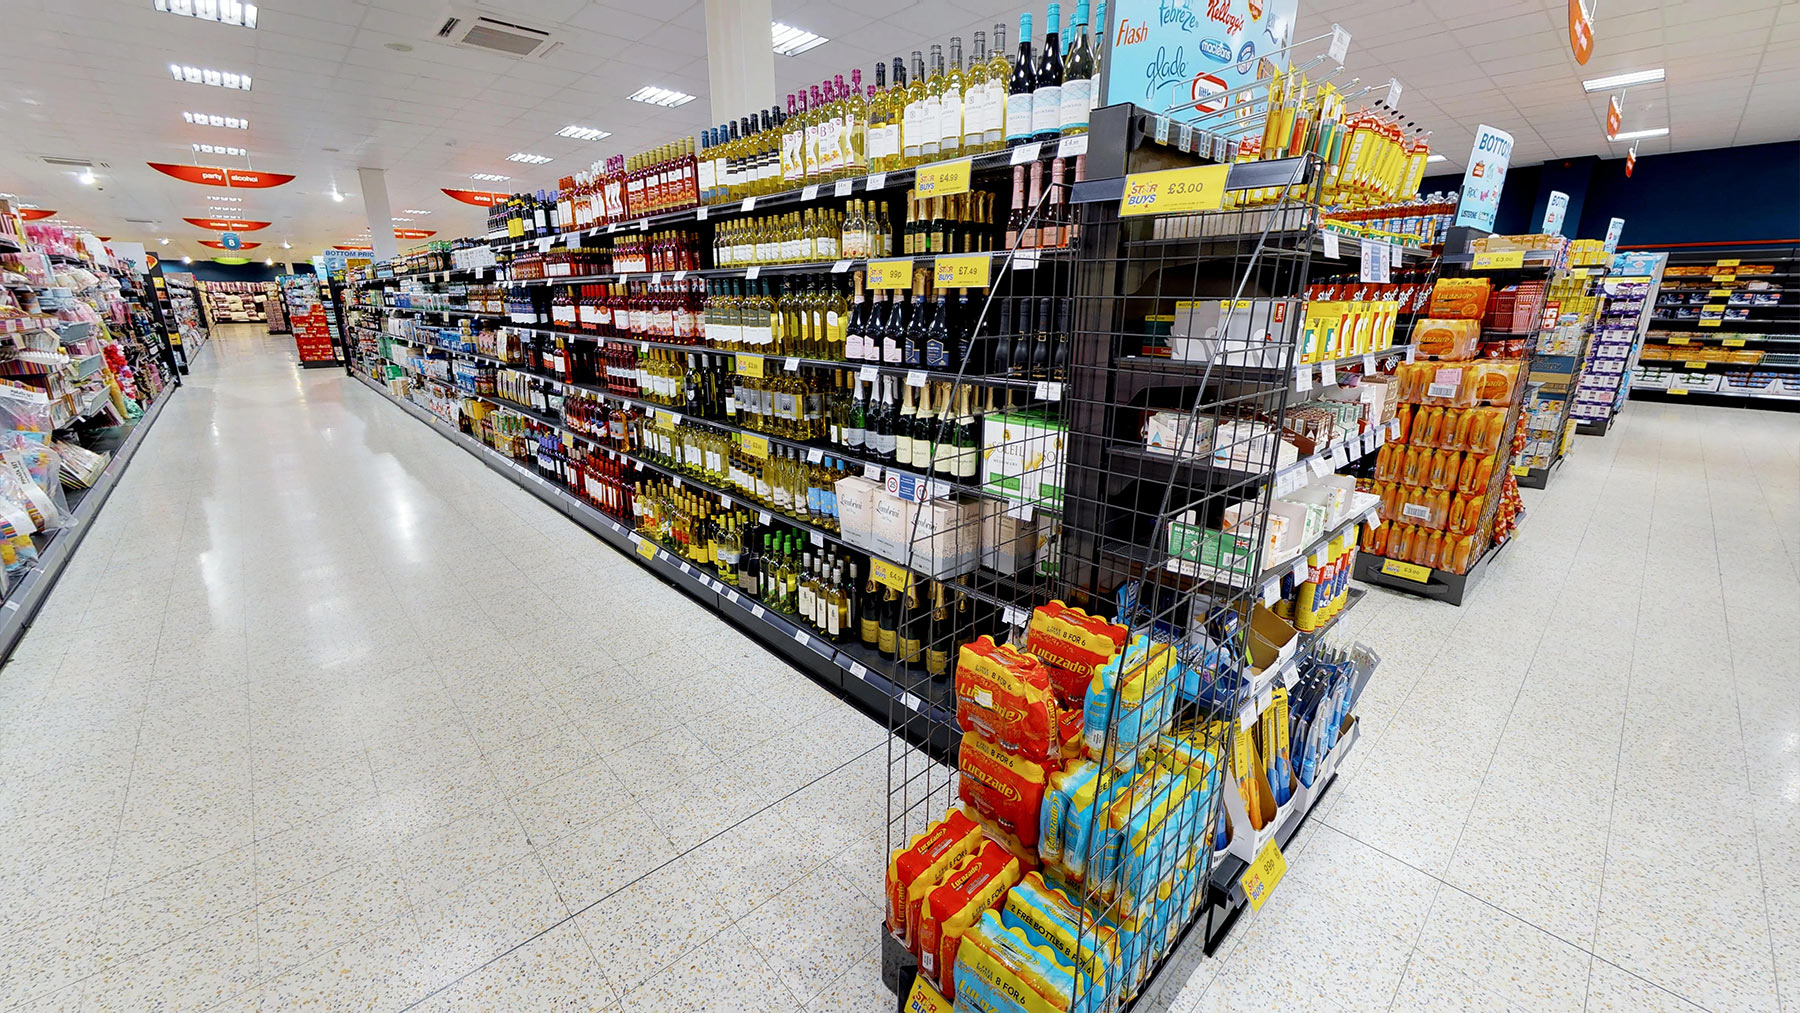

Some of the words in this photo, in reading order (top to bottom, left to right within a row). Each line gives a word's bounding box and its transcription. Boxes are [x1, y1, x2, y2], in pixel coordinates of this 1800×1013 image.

[1206, 0, 1244, 36] Kellogg's
[1116, 18, 1148, 47] Flash
[1201, 41, 1231, 61] macleans
[1146, 46, 1187, 100] glade
[920, 183, 935, 191] BUYS
[940, 173, 958, 182] £4.99
[1167, 182, 1204, 194] £3.00
[1128, 194, 1157, 205] BUYS
[228, 239, 235, 247] 8
[889, 270, 902, 279] 99p
[938, 273, 954, 281] BUYS
[958, 266, 978, 276] £7.49
[1403, 567, 1421, 575] £3.00
[1062, 631, 1068, 639] 8
[1068, 633, 1082, 645] FOR
[1081, 639, 1086, 647] 6
[1030, 643, 1087, 675] Lucozade
[960, 682, 1017, 721] Luade
[990, 749, 996, 757] 8
[996, 753, 1009, 766] FOR
[1008, 760, 1014, 768] 6
[961, 759, 1014, 798] Lucozade
[917, 829, 944, 854] Lucozade
[1263, 859, 1276, 875] 99p
[951, 864, 980, 890] Lucozade
[1010, 904, 1016, 912] 2
[1016, 908, 1033, 925] FREE
[1033, 922, 1064, 951] BOTTLES
[995, 976, 1002, 986] 8
[1002, 982, 1020, 1001] FOR
[1019, 996, 1026, 1005] 6
